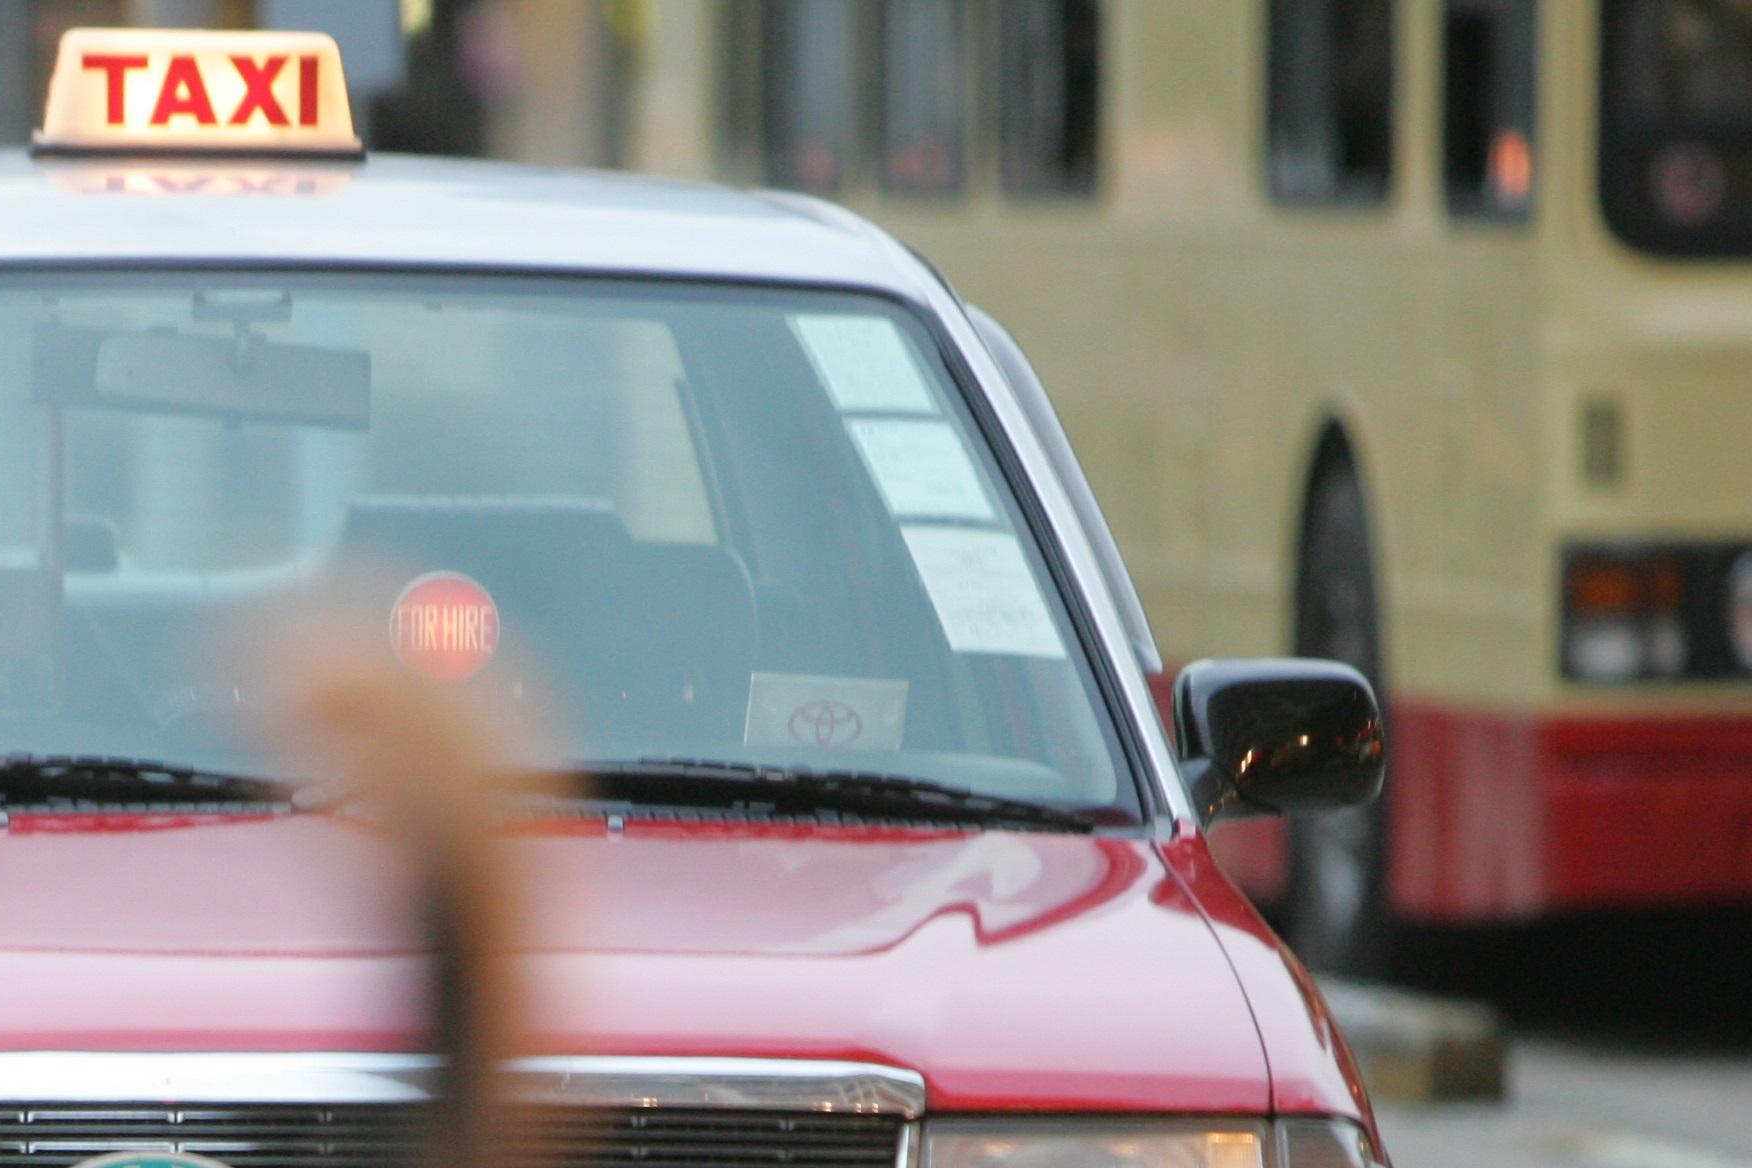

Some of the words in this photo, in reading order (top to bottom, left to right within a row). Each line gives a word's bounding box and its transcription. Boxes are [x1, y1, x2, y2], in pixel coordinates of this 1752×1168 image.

[82, 55, 319, 126] TAXI
[397, 604, 438, 650] FOR
[443, 604, 494, 653] HIRE
